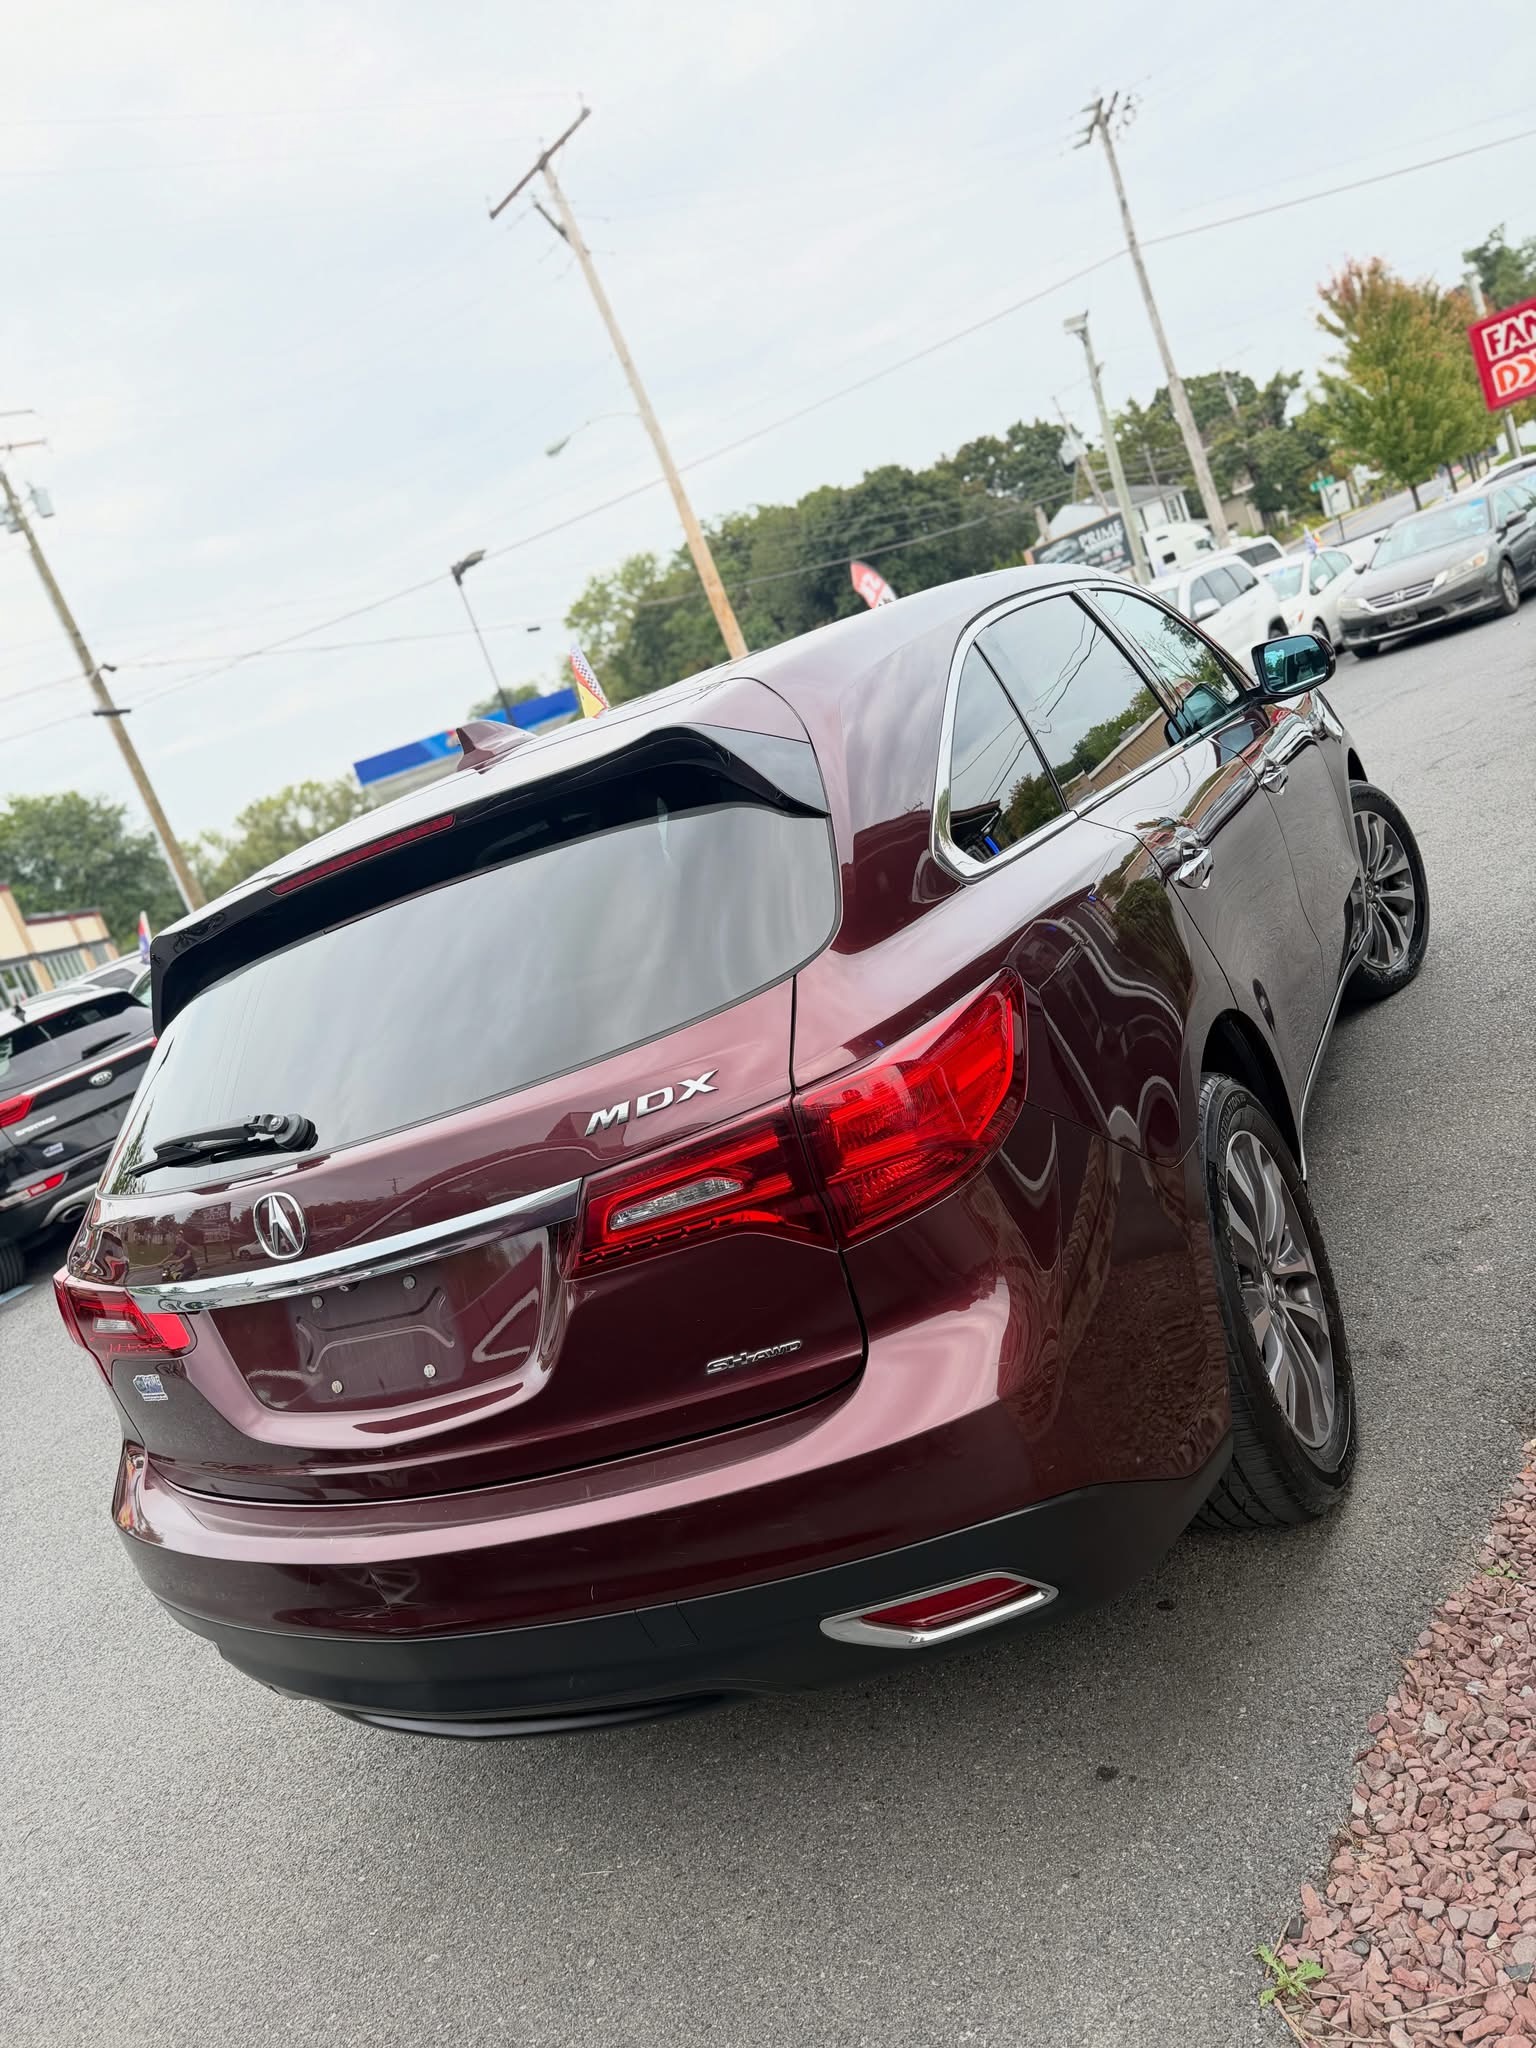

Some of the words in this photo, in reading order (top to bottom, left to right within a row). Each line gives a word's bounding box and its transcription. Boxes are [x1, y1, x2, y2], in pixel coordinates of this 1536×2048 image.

[1078, 519, 1123, 548] PRIME
[584, 1068, 719, 1137] MDX
[706, 1340, 801, 1375] SH-AWD
